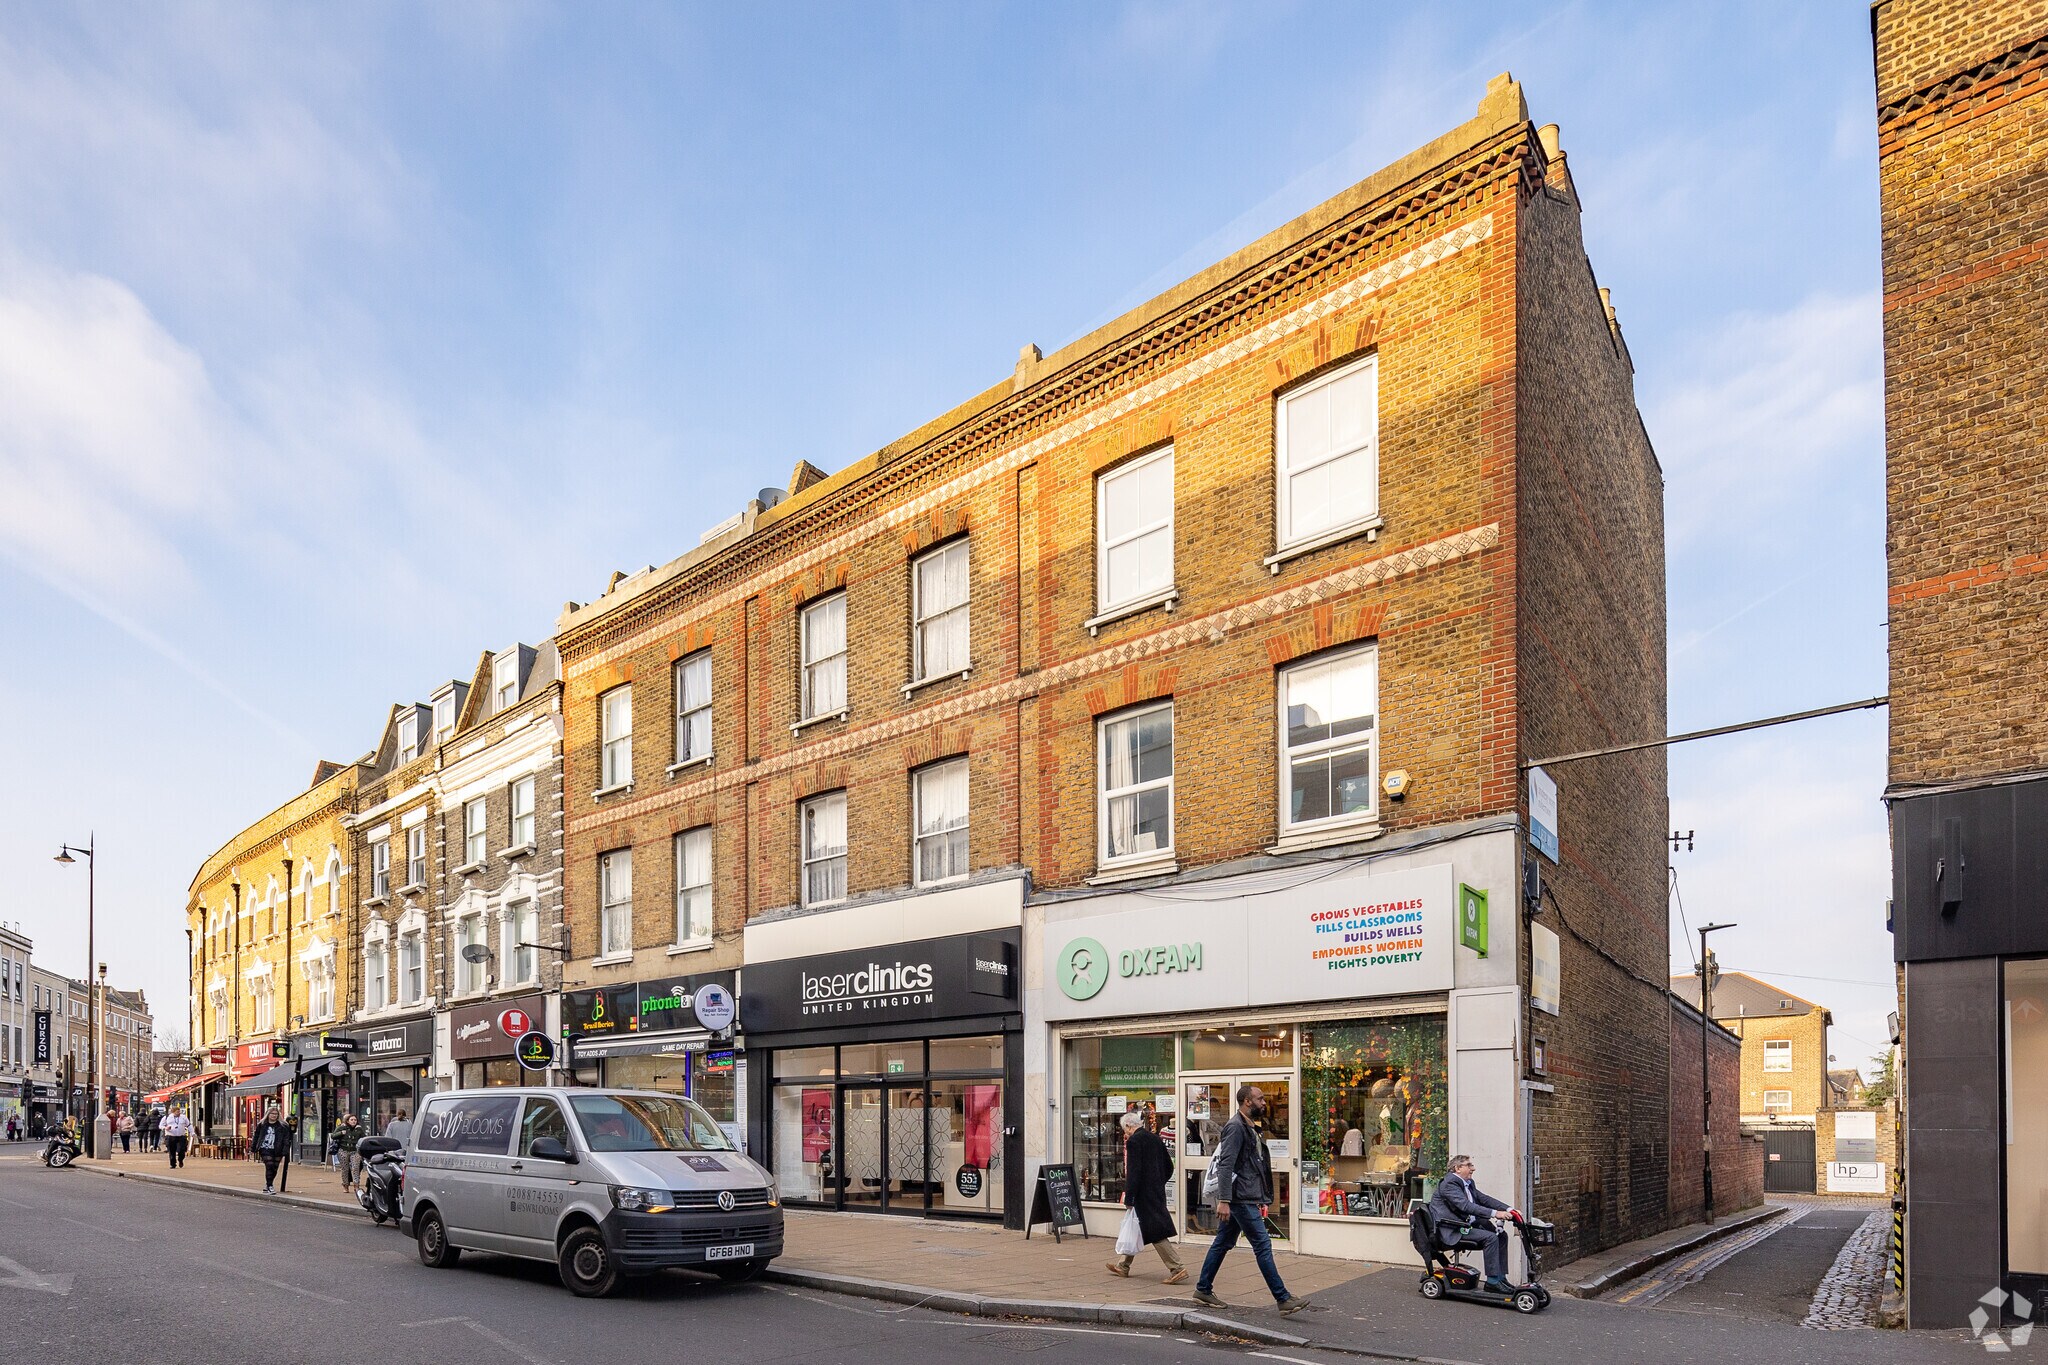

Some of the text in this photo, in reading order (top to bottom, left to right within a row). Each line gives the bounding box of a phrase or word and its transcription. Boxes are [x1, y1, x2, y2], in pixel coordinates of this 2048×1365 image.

[1388, 778, 1401, 787] ADT
[1310, 898, 1423, 922] GROWS VEGETABLES
[1316, 911, 1423, 934] FILLS CLASSROOMS
[1344, 924, 1423, 943] BUILDS WELLS
[1466, 925, 1478, 940] OXFAM
[1312, 938, 1423, 960] EMPOWERS WOMEN
[976, 957, 1008, 972] laserclinics
[1118, 942, 1202, 978] OXFAM
[1328, 951, 1423, 970] FIGHTS POVERTY
[802, 961, 933, 1000] laserclinics
[641, 995, 681, 1016] phone
[802, 994, 933, 1015] UNITED KINGDOM
[38, 1016, 47, 1059] CURZON
[248, 1042, 270, 1058] TORTILLA
[661, 1044, 675, 1052] SAME
[686, 1042, 705, 1050] REPAIR
[1104, 1072, 1175, 1081] WWW.OXFAM.ORG.UK
[1122, 1065, 1148, 1073] ONLINE
[430, 1111, 505, 1139] SW BLOOMS
[961, 1173, 973, 1184] 55
[1838, 1163, 1858, 1178] hp
[507, 1187, 564, 1204] 02088745559
[516, 1202, 560, 1216] @SWBLOOMS
[709, 1245, 751, 1258] GF68 HNO
